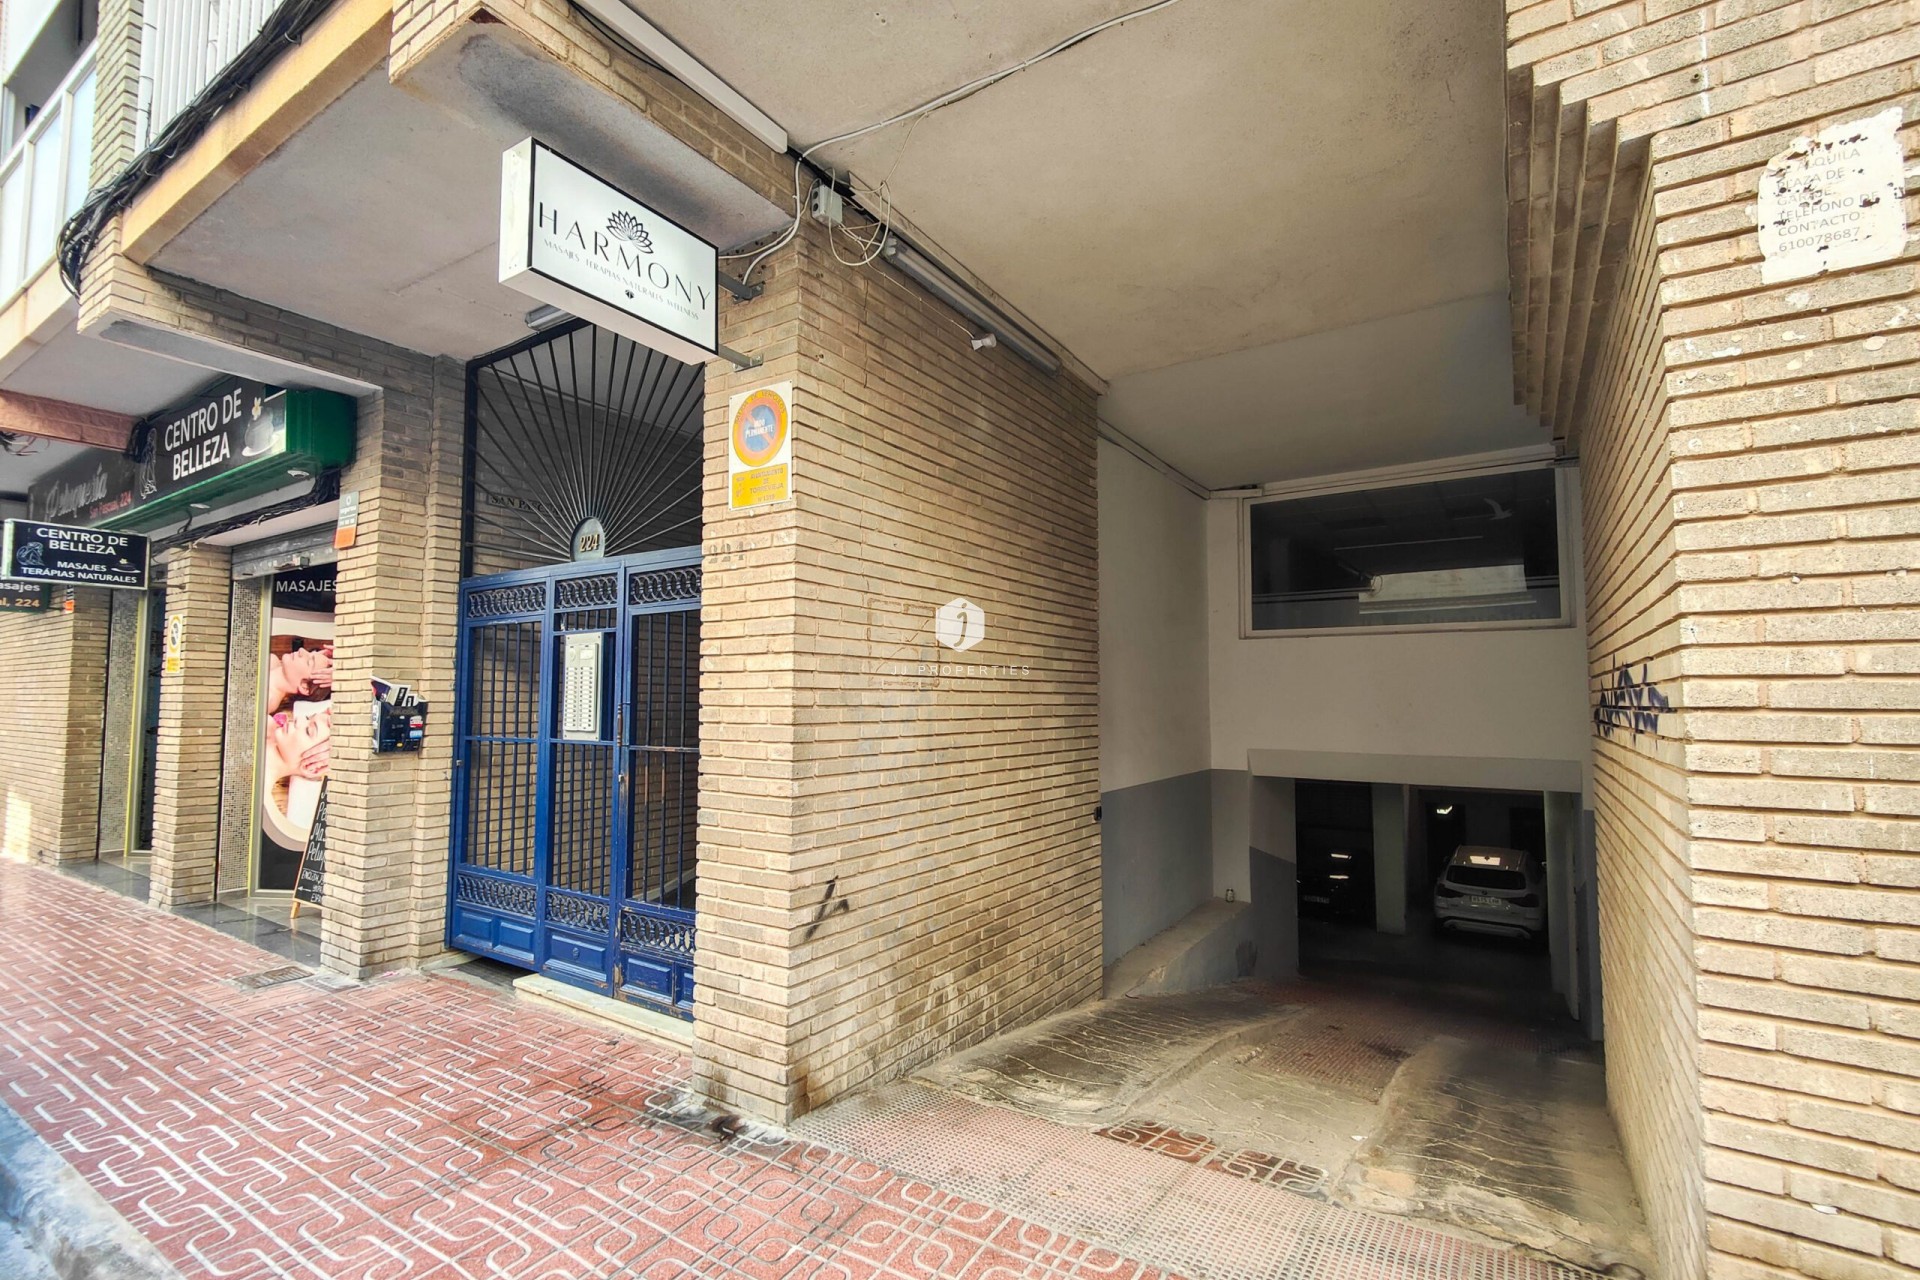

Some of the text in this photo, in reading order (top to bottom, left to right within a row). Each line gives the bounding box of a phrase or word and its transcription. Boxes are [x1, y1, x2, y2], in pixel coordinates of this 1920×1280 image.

[1777, 167, 1845, 190] PLAZA DE
[1777, 197, 1854, 221] TELEFONO
[543, 238, 580, 262] MASAJES
[1779, 226, 1861, 252] 610078687
[538, 201, 711, 310] HARMONY
[164, 387, 242, 452] CENTRO DE
[172, 431, 231, 481] BELLEZA
[36, 527, 129, 547] CENTRO DE
[48, 539, 117, 556] BELLEZA
[580, 533, 600, 552] 224
[56, 561, 107, 572] MASAJES
[77, 571, 138, 584] NATURALES
[14, 598, 41, 608] 224
